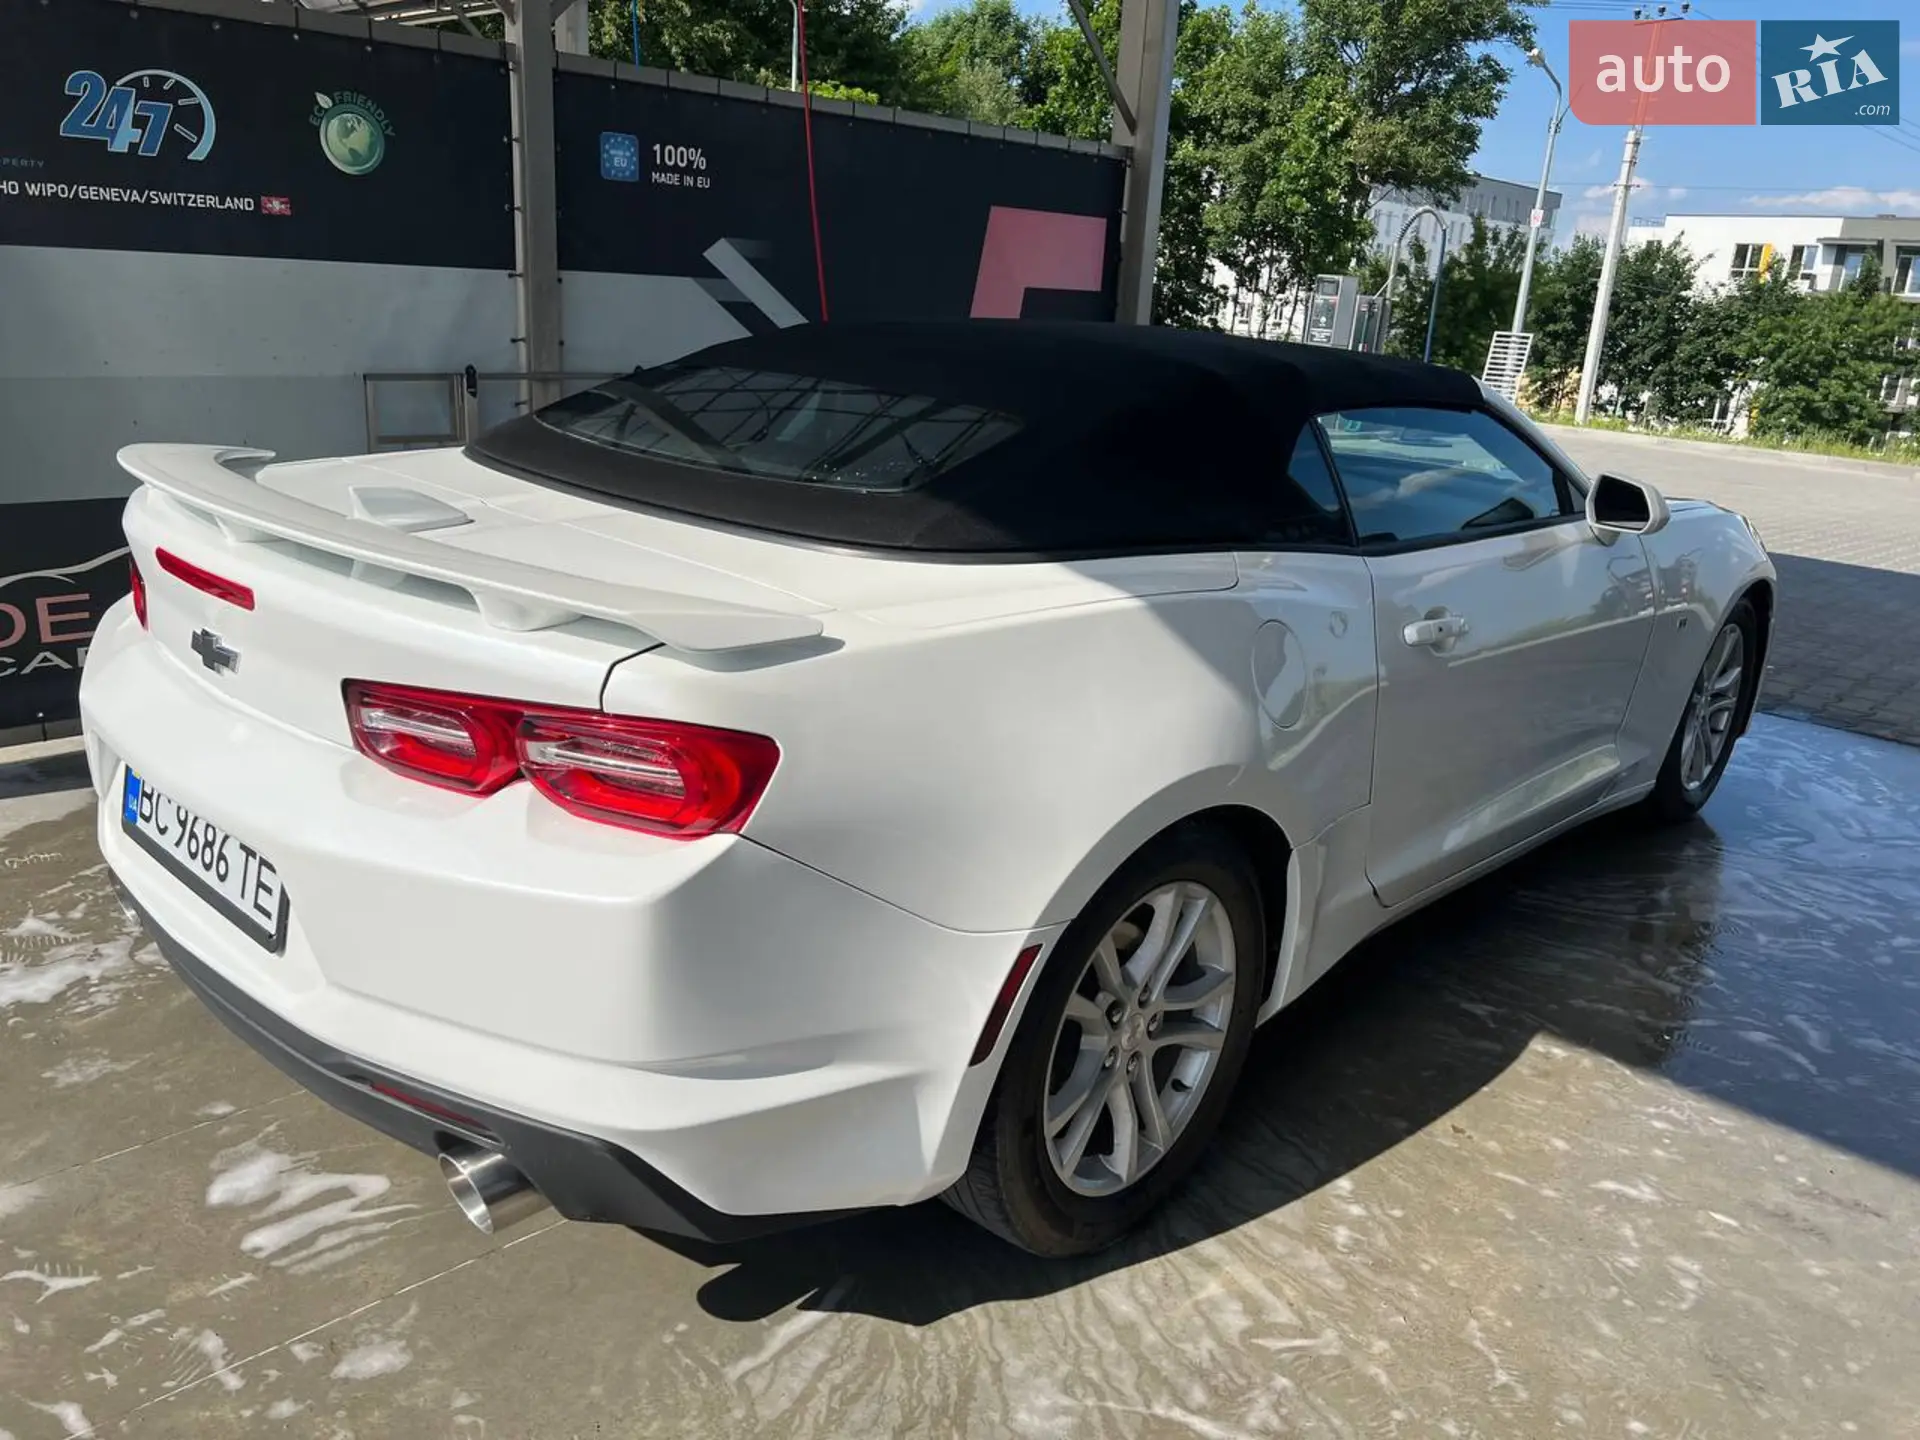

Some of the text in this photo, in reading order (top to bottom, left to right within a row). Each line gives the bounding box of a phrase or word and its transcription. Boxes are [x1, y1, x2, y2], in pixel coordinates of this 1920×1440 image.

[333, 91, 396, 136] FRIENDLY
[614, 156, 628, 168] EU
[653, 143, 707, 170] 100%
[652, 172, 711, 188] MADE IN EU
[139, 779, 277, 921] BC 9686 TE
